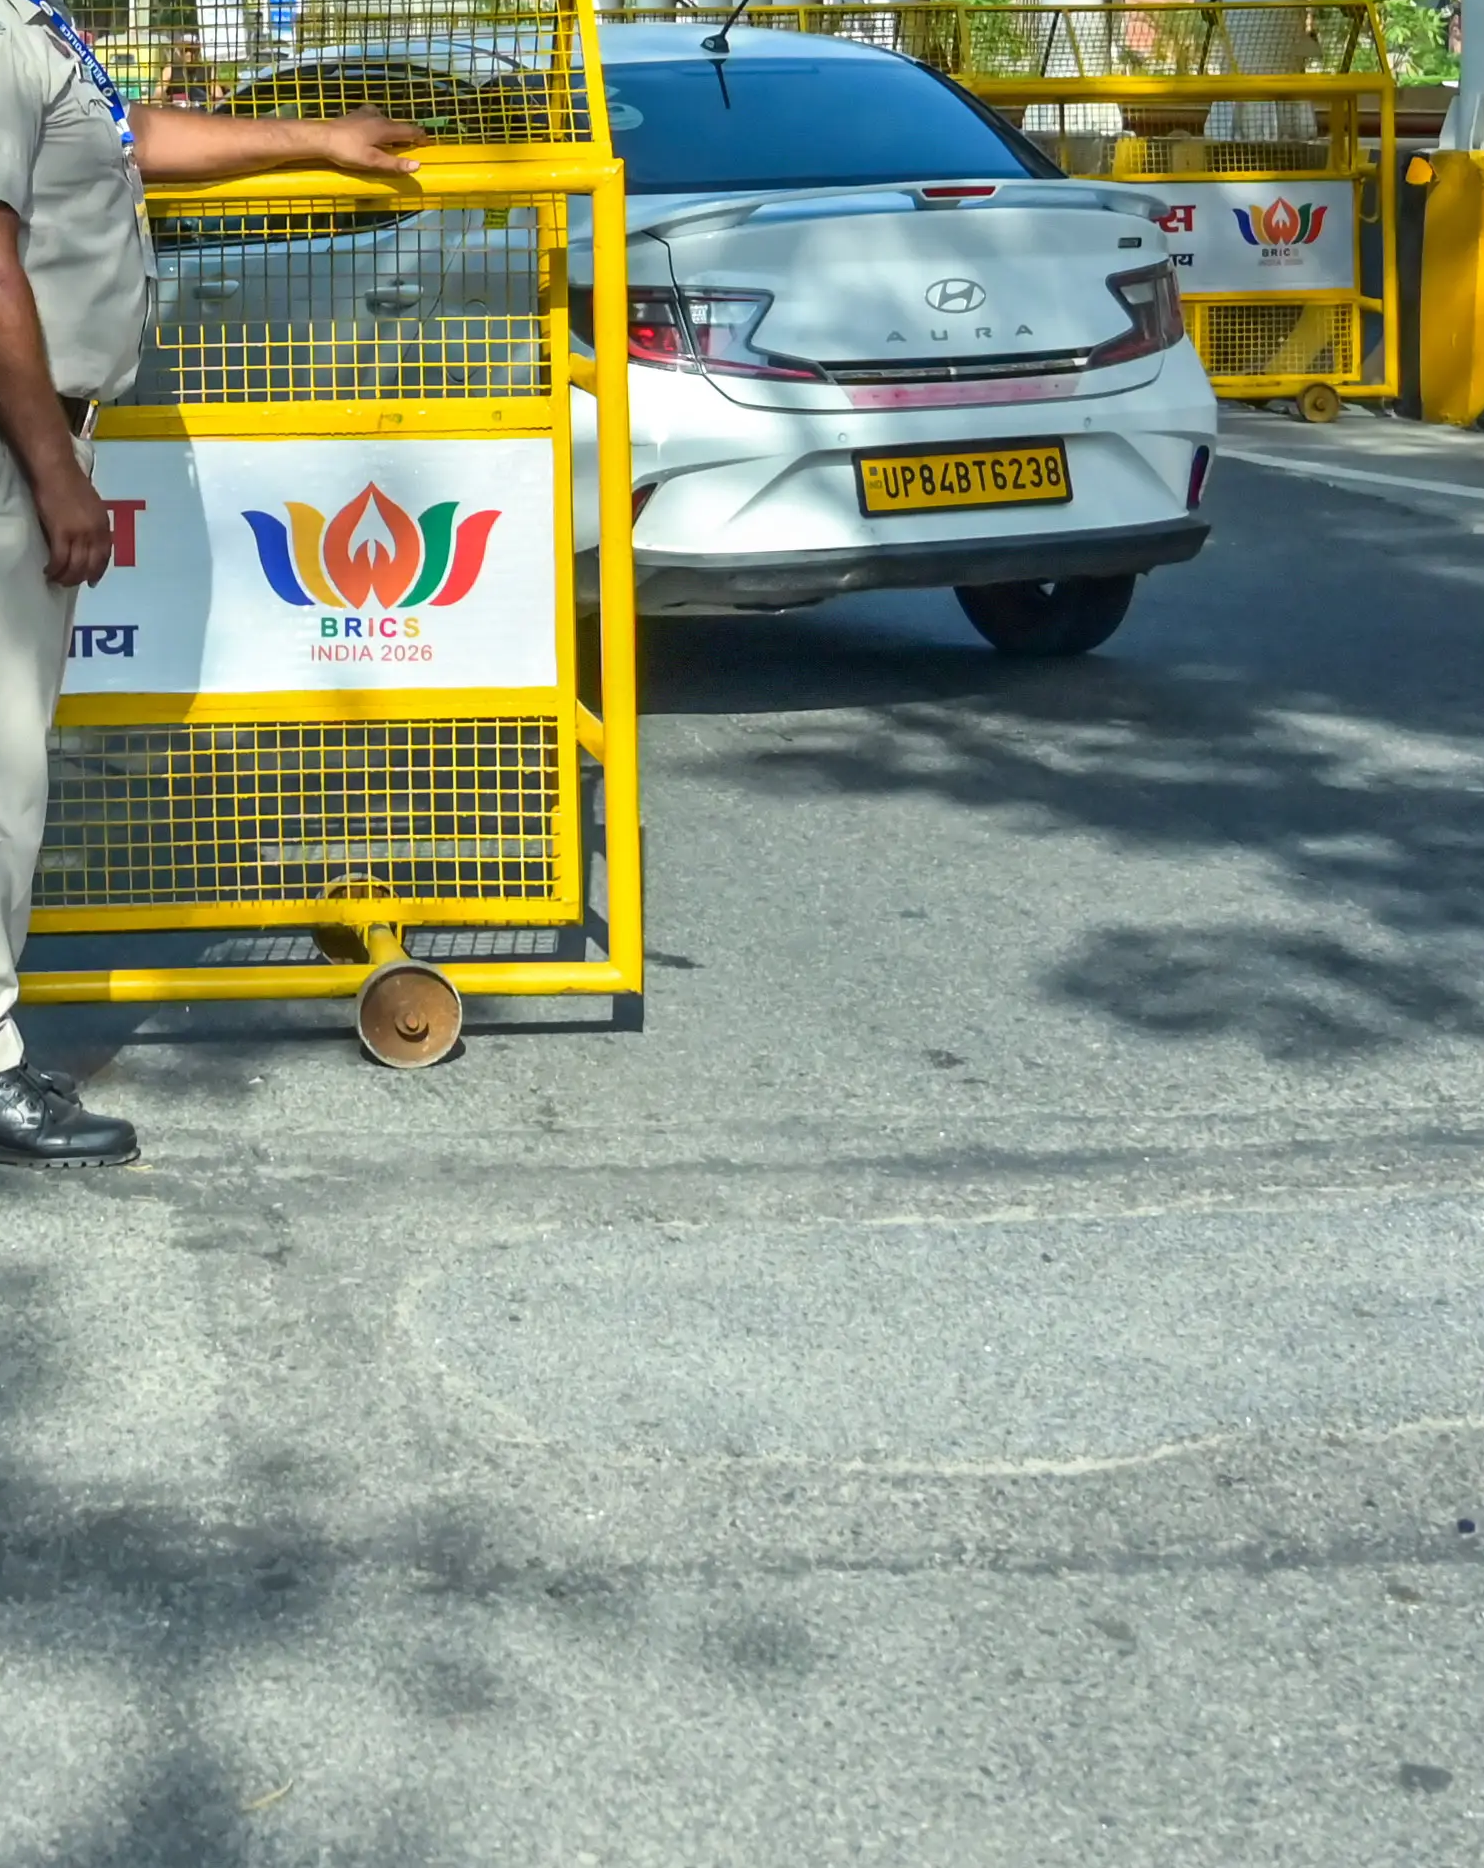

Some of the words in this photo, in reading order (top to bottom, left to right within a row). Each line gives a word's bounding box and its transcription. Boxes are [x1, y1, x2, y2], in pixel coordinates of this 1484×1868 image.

[59, 23, 87, 57] POLICE
[84, 54, 107, 85] DELHI
[885, 323, 1033, 343] AURA
[882, 455, 1061, 498] UP84BT6238
[321, 617, 421, 638] BRICS
[311, 644, 373, 661] INDIA
[381, 644, 433, 661] 2026
